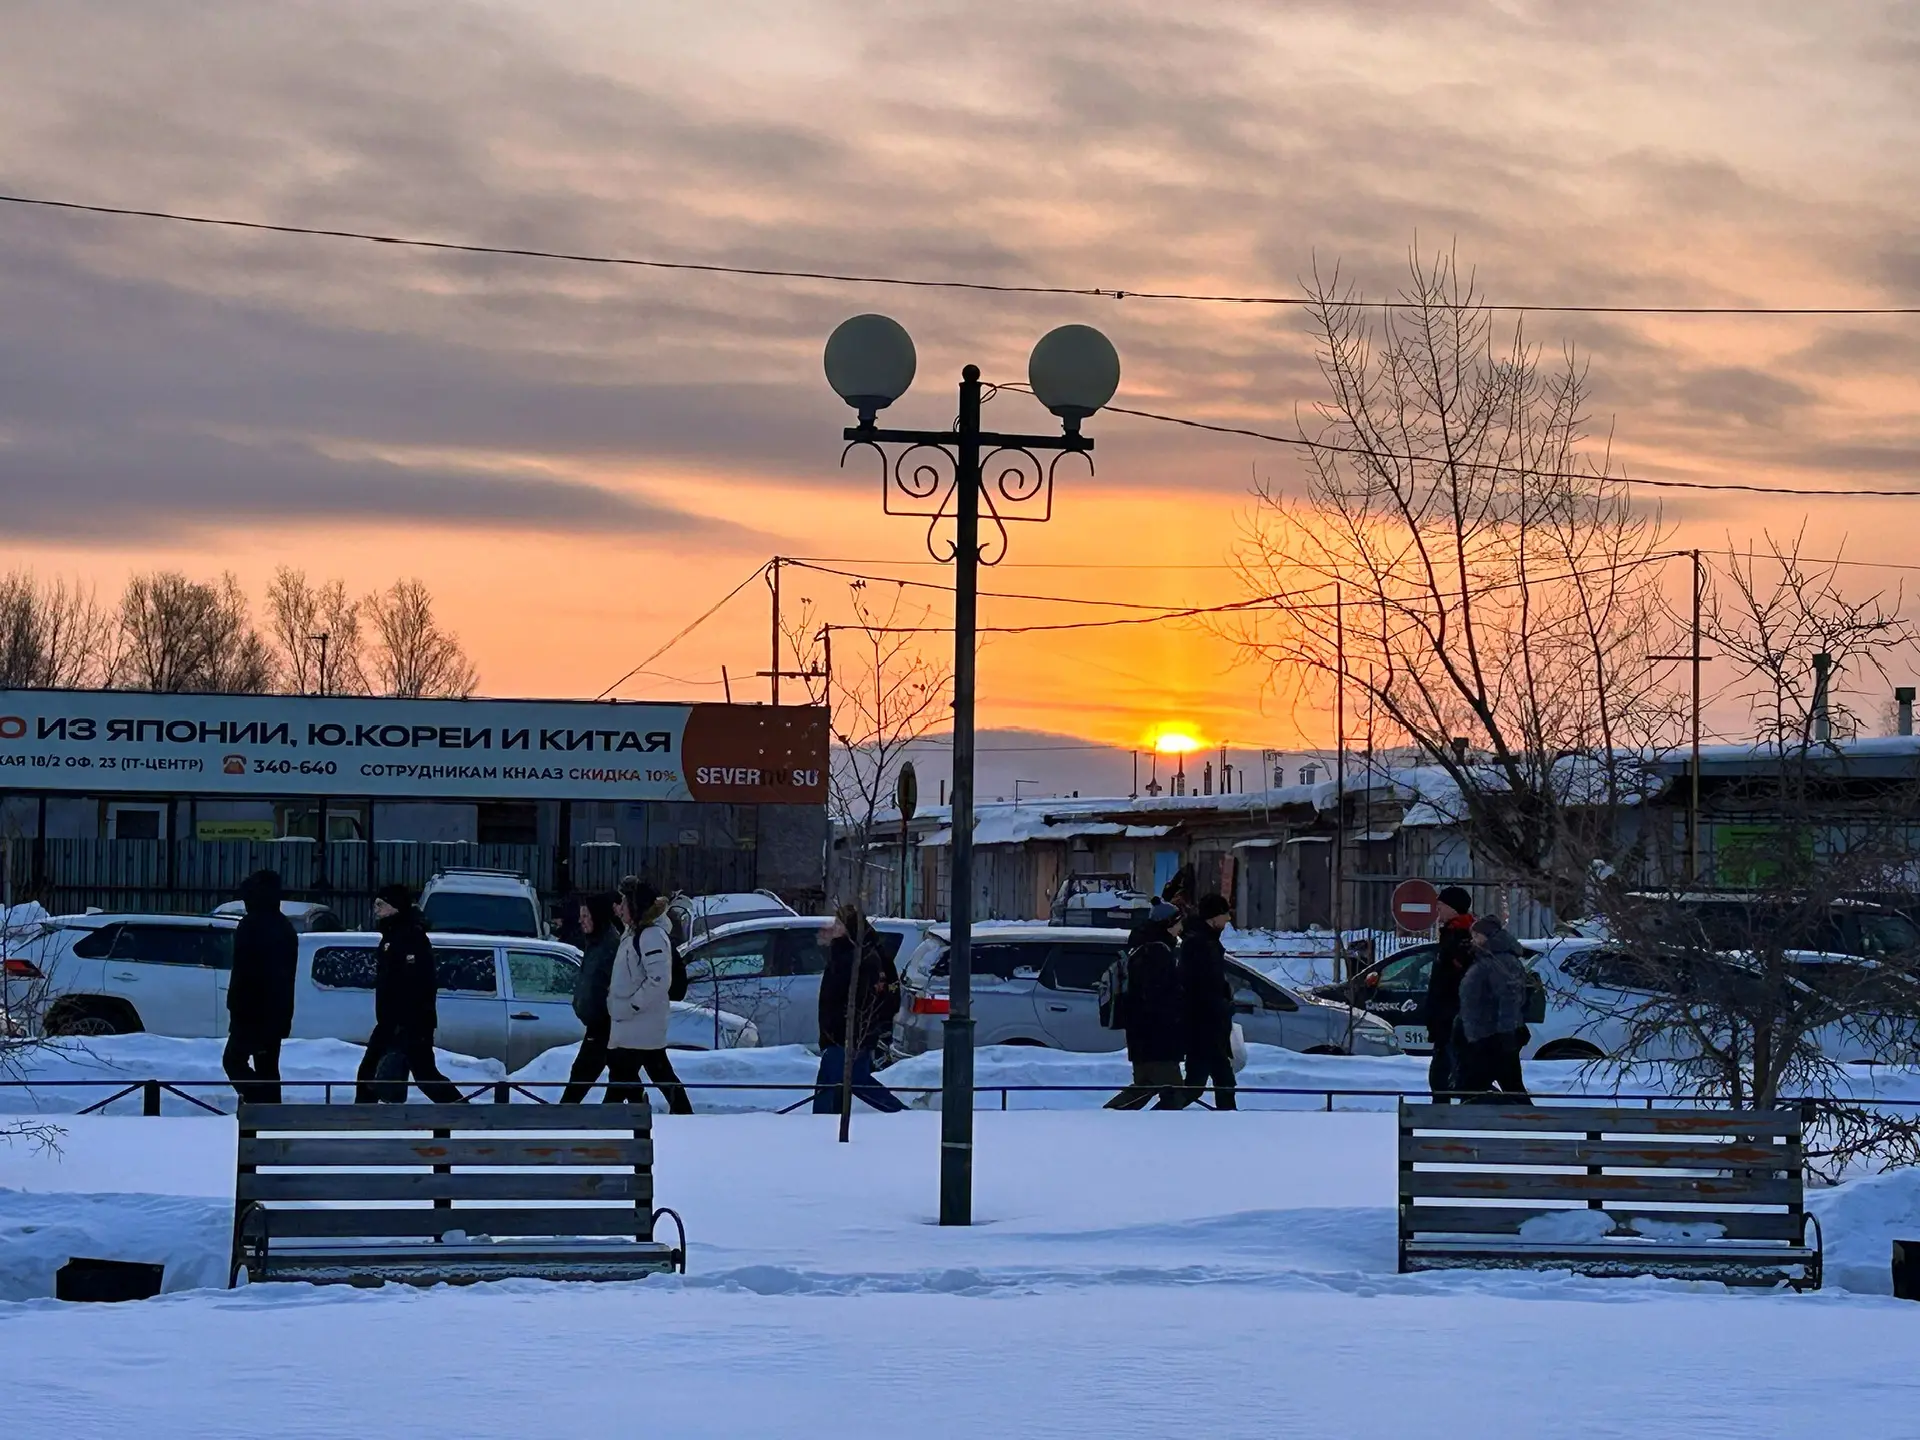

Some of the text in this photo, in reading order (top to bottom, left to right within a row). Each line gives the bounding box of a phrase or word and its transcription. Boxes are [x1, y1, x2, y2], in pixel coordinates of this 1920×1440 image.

[37, 717, 97, 741] ИЗ
[106, 718, 298, 748] ЯПОНИИ,
[307, 723, 492, 749] Ю.КОРЕИ
[501, 728, 530, 750] И
[539, 728, 672, 753] КИТАЯ
[30, 753, 61, 768] 18/2
[64, 756, 94, 768] ОФ.
[98, 757, 117, 769] 23
[253, 759, 338, 775] 340-640
[359, 763, 678, 783] СОТРУДНИКАМ КНААЗ СКИДКА 10%
[696, 766, 788, 786] SEVER
